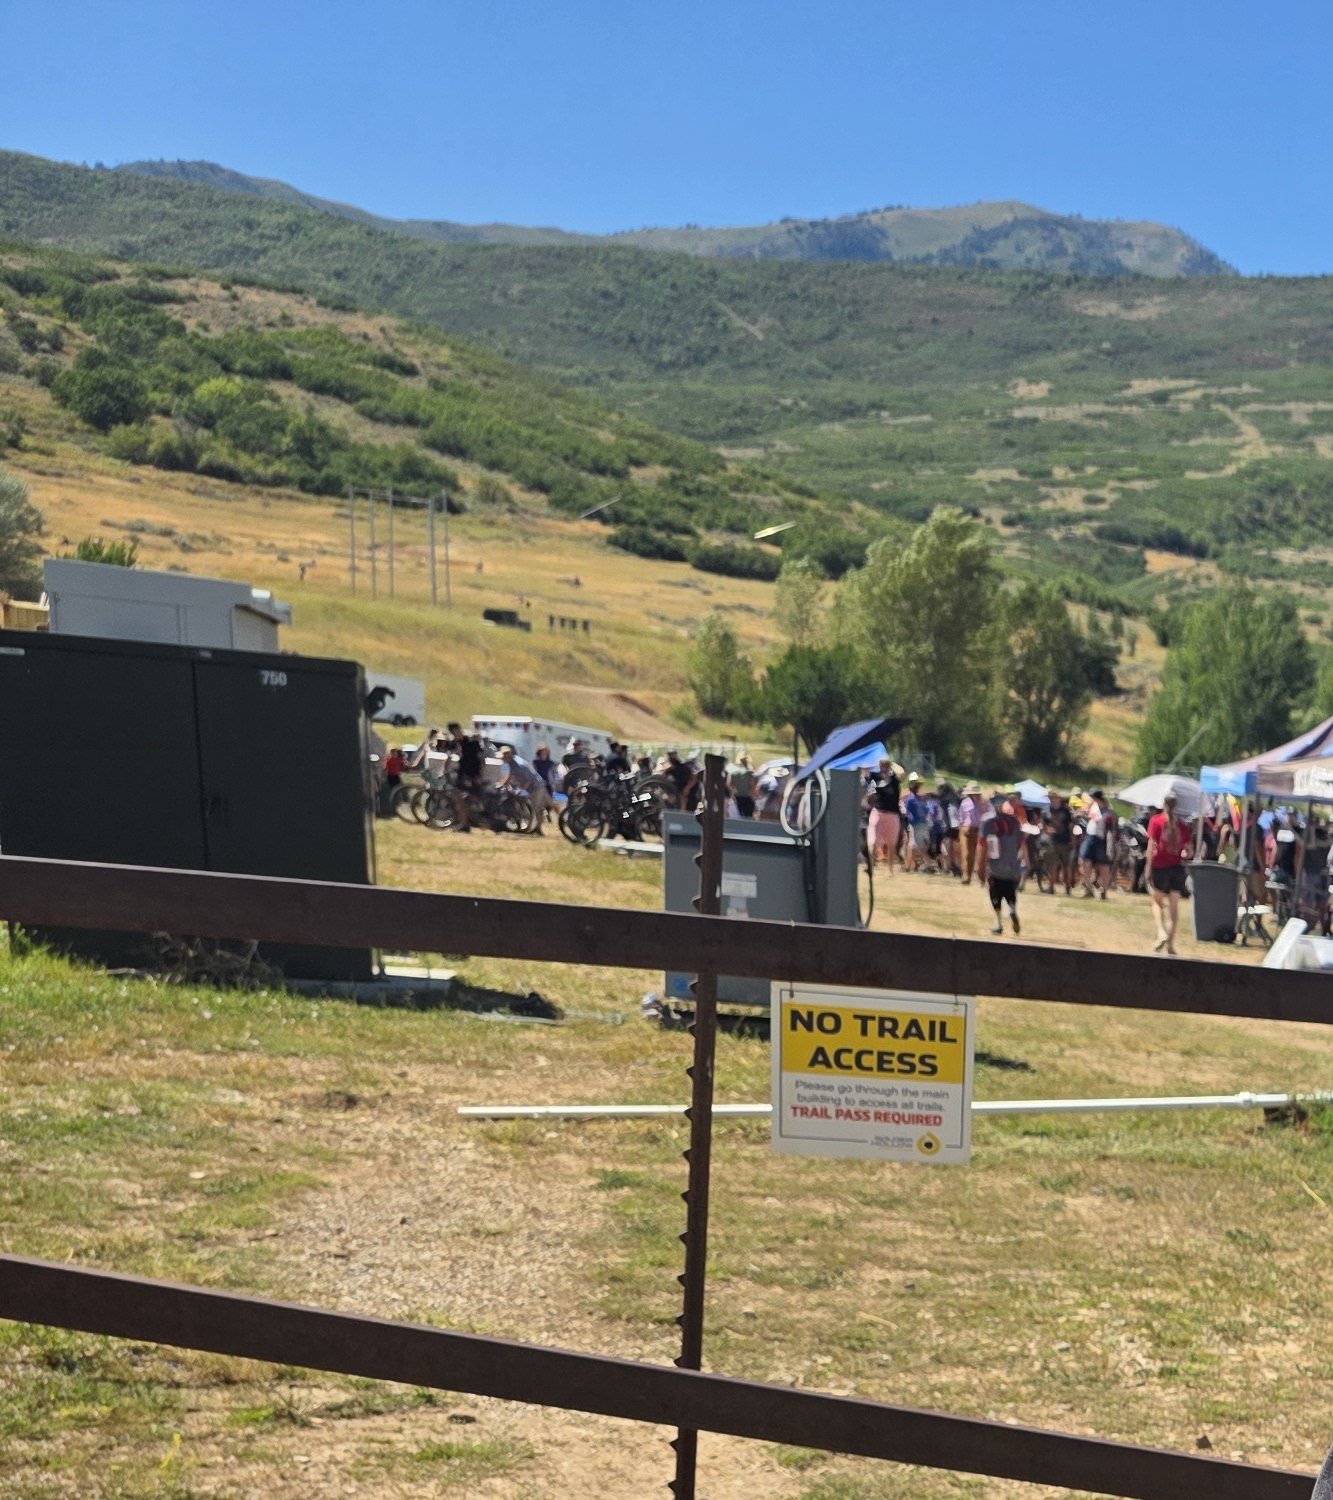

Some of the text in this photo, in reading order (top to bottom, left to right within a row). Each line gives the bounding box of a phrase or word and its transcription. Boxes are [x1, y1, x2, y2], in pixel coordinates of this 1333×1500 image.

[790, 1009, 957, 1043] NO TRAIL
[808, 1046, 938, 1076] ACCESS
[795, 1079, 949, 1099] Please go through the main
[797, 1093, 842, 1107] building
[844, 1096, 856, 1106] to
[859, 1099, 897, 1109] access
[901, 1099, 913, 1109] all
[790, 1105, 943, 1127] TRAIL PASS REQUIRED
